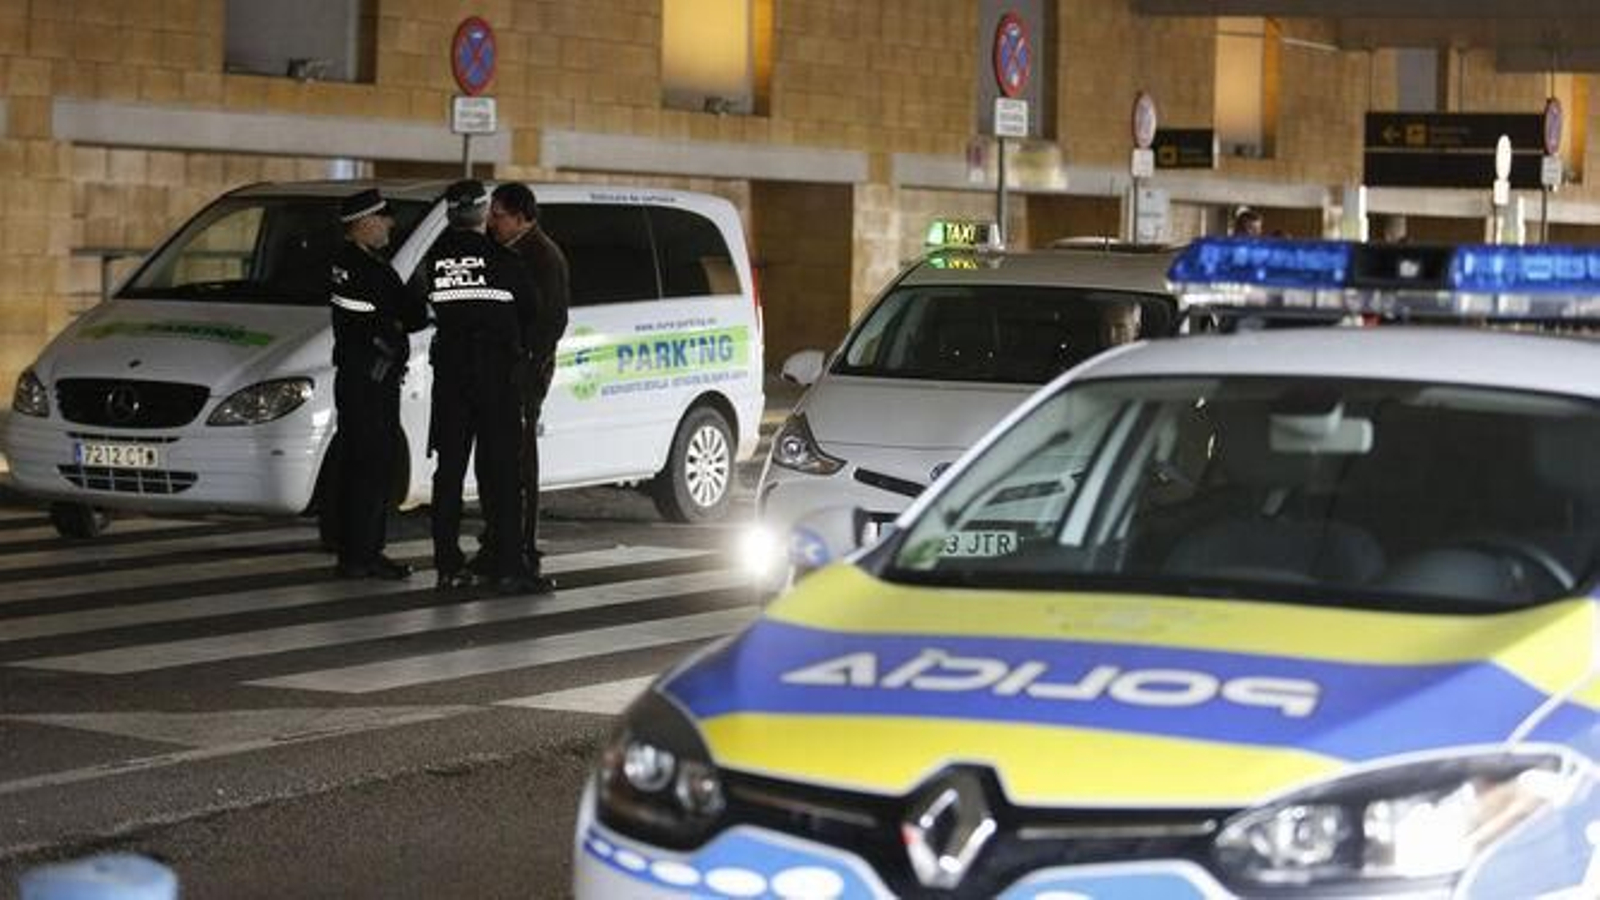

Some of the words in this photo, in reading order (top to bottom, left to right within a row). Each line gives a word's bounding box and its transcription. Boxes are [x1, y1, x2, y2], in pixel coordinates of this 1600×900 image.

[945, 222, 976, 243] TAXI
[434, 274, 487, 289] SEVILLA
[616, 333, 733, 374] PARKING
[85, 444, 121, 464] 7212
[967, 533, 1013, 554] JTR
